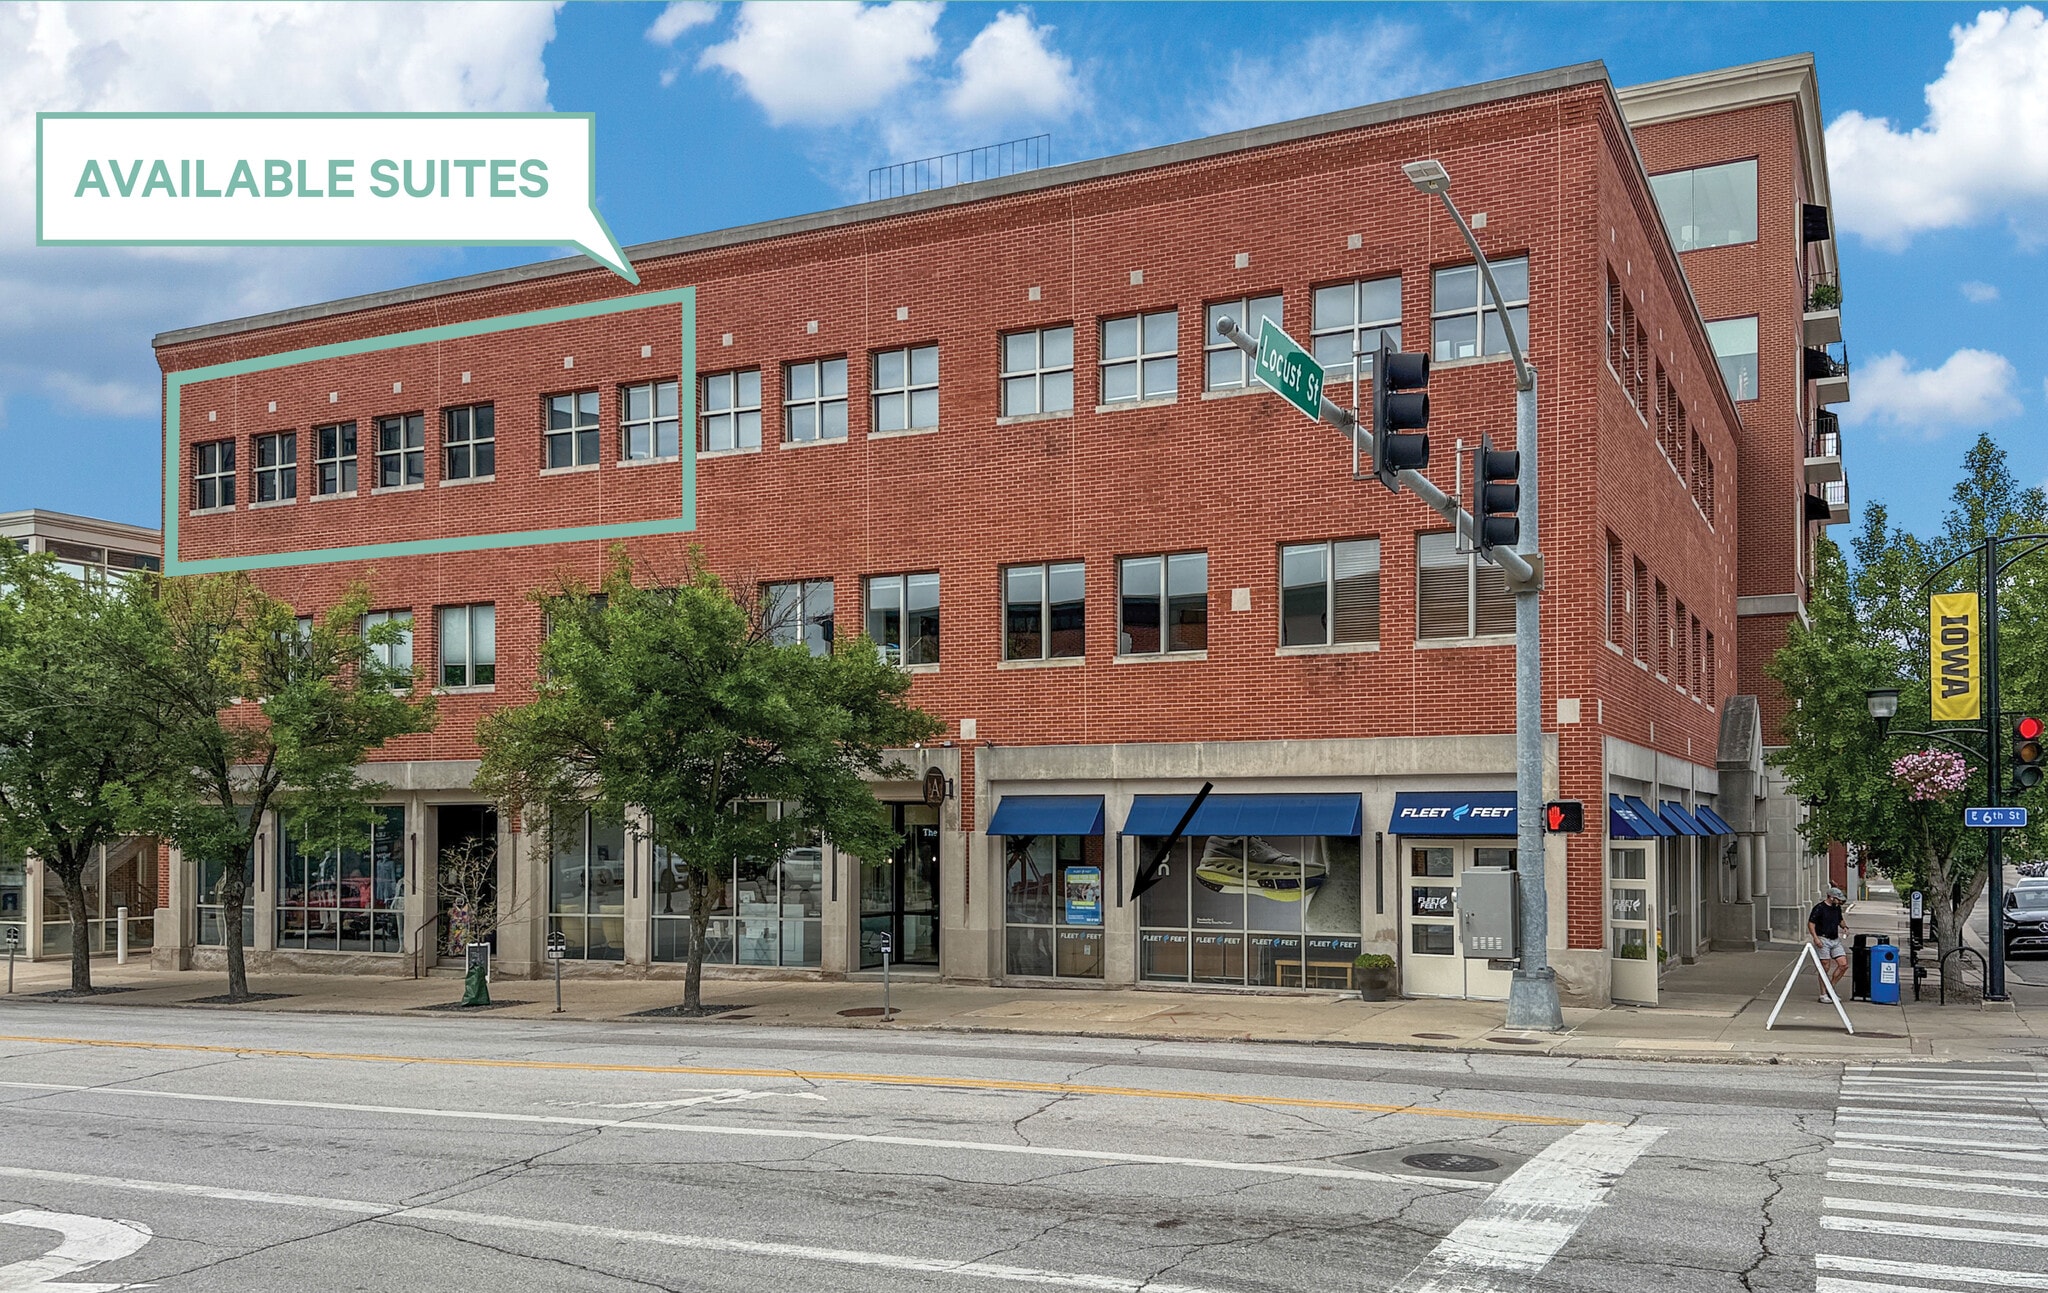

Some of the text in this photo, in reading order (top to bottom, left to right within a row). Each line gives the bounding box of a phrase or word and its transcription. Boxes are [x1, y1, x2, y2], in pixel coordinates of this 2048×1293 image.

[1261, 334, 1320, 407] Locust St
[1941, 614, 1970, 699] IOWA
[930, 778, 940, 798] A
[1400, 807, 1514, 818] FLEET FEET
[1982, 811, 2004, 824] 6th
[2008, 811, 2020, 820] St
[922, 828, 938, 837] The
[1417, 896, 1441, 904] FLEET
[1142, 934, 1162, 942] FLEET
[1195, 936, 1241, 945] FLEET FEET
[1251, 938, 1299, 947] FLEET FEET
[1309, 940, 1358, 949] FLEET FEET
